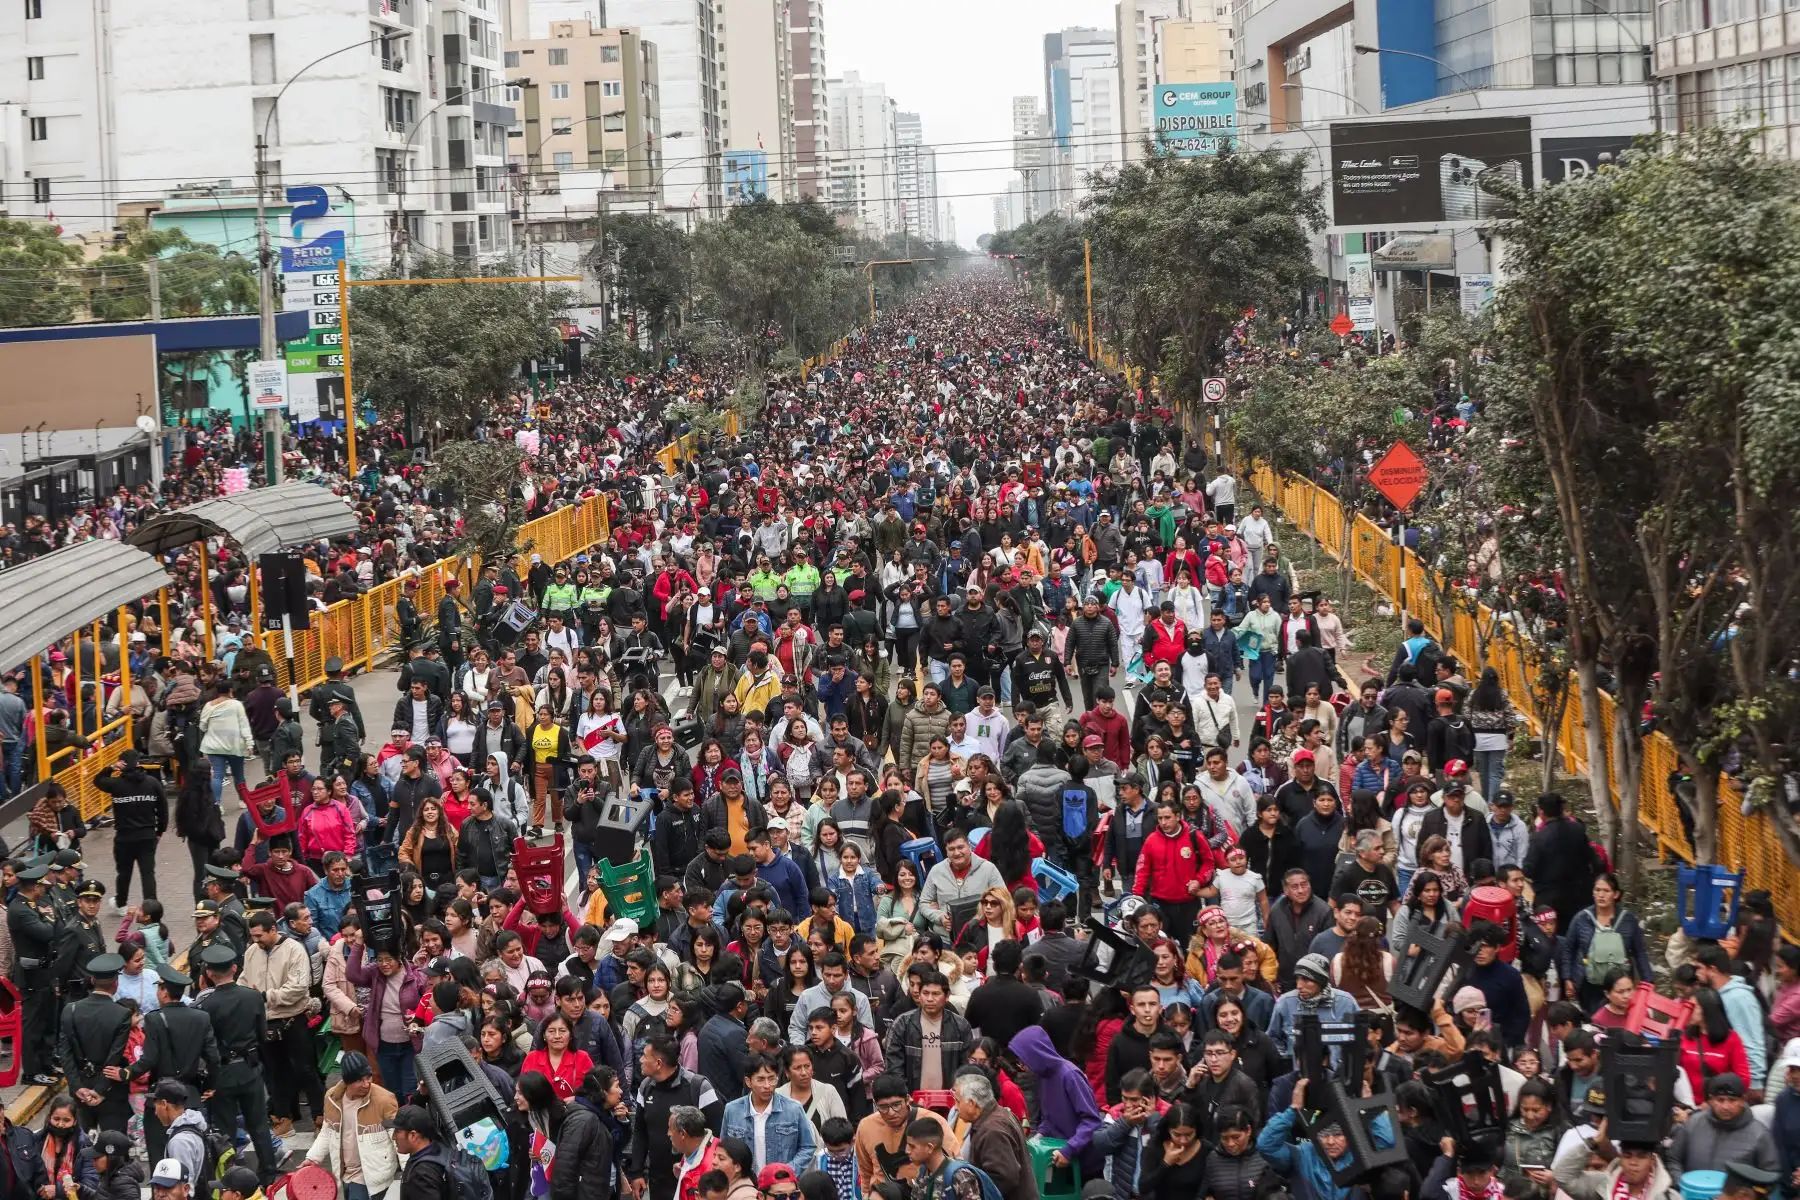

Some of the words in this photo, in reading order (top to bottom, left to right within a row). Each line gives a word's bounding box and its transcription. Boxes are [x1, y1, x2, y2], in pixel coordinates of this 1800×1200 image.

[1179, 92, 1199, 101] CEM
[1200, 91, 1231, 99] GROUP
[1159, 115, 1233, 131] DISPONIBLE
[291, 247, 332, 258] PETRO
[1380, 467, 1421, 475] DISMINUIR
